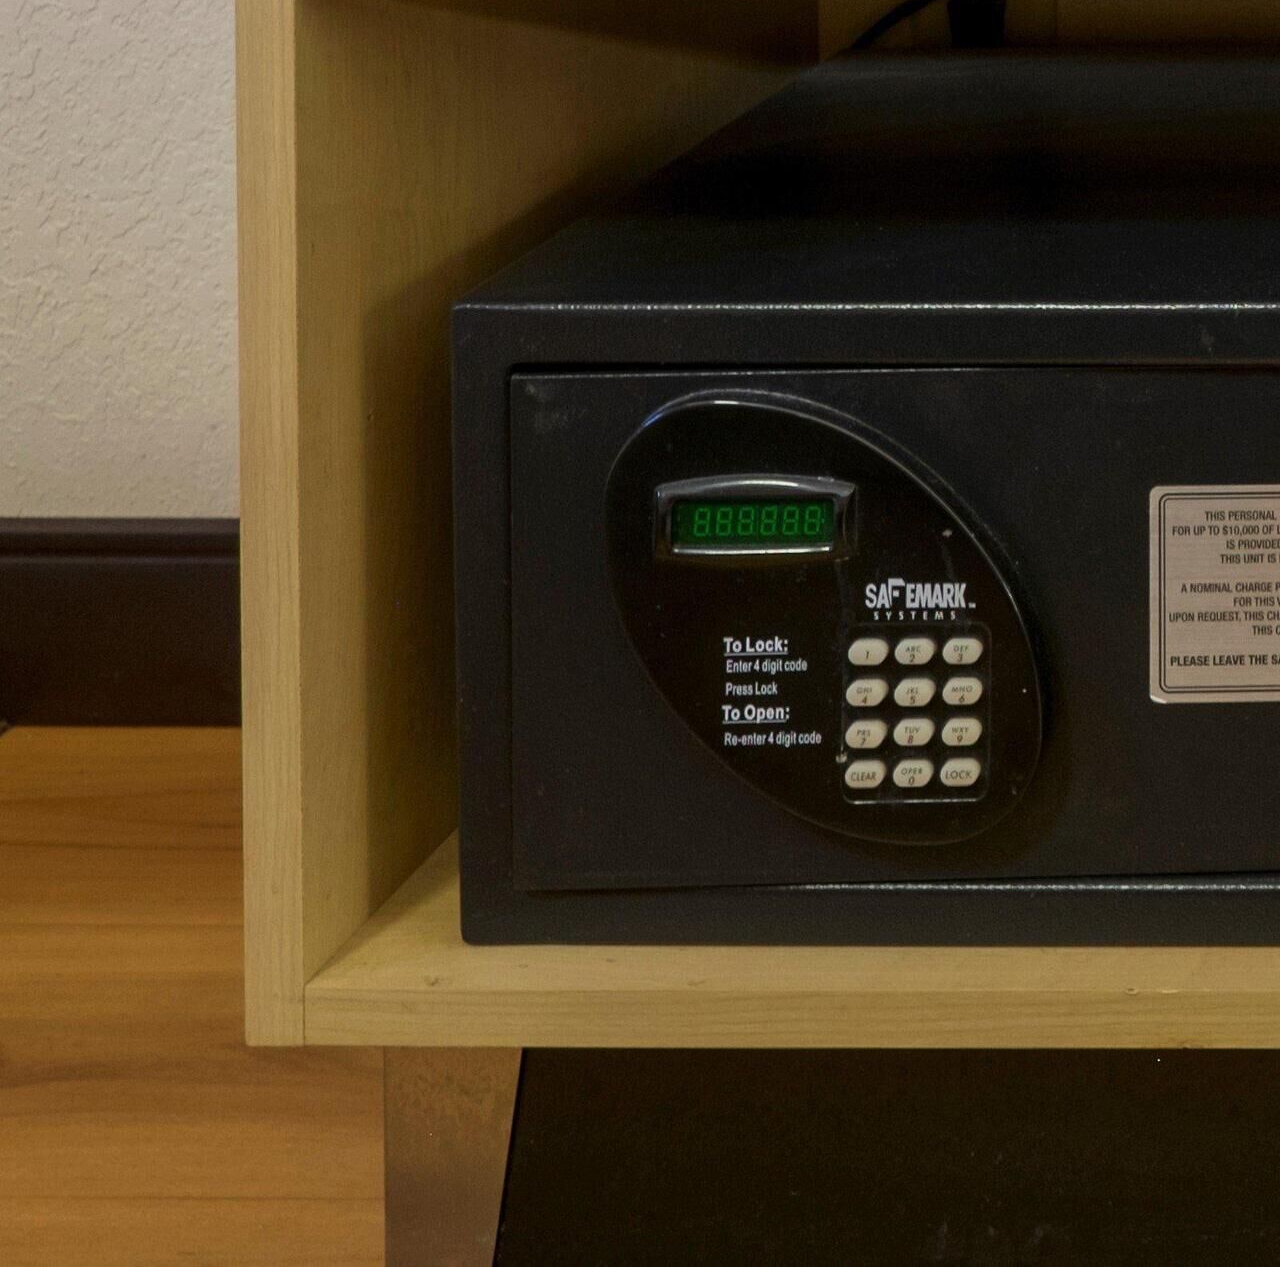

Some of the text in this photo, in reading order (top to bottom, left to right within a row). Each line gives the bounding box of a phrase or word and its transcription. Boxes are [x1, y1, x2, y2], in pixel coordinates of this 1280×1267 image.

[1205, 512, 1225, 521] THIS
[1228, 511, 1276, 521] PERSONAL
[1173, 526, 1190, 536] FOR
[1193, 526, 1206, 536] UP
[1208, 526, 1220, 535] TO
[1222, 525, 1260, 536] $10,000
[1262, 525, 1274, 535] OF
[1226, 540, 1235, 550] IS
[1221, 554, 1241, 564] THIS
[1243, 554, 1264, 564] UNIT
[1267, 554, 1277, 564] IS
[1181, 583, 1188, 593] A
[1190, 583, 1232, 593] NOMINAL
[1235, 582, 1272, 592] CHARGE
[865, 578, 966, 609] SAFEMARK
[1233, 597, 1252, 607] FOR
[1255, 596, 1275, 607] THIS
[873, 611, 956, 621] SYSTEMS
[1169, 612, 1195, 622] UPON
[1197, 612, 1241, 623] REQUEST,
[1244, 611, 1264, 621] THIS
[1252, 625, 1273, 635] THIS
[723, 636, 788, 653] To Lock:
[726, 658, 808, 675] Enter 4 digit code
[1170, 656, 1210, 667] PLEASE
[1213, 655, 1246, 666] LEAVE
[1248, 655, 1268, 666] THE
[725, 681, 778, 695] Press Lock
[722, 704, 790, 724] To Open:
[724, 730, 822, 748] Re-enter 4 digit code
[850, 771, 877, 782] CLEAR
[945, 770, 973, 780] LOCK
